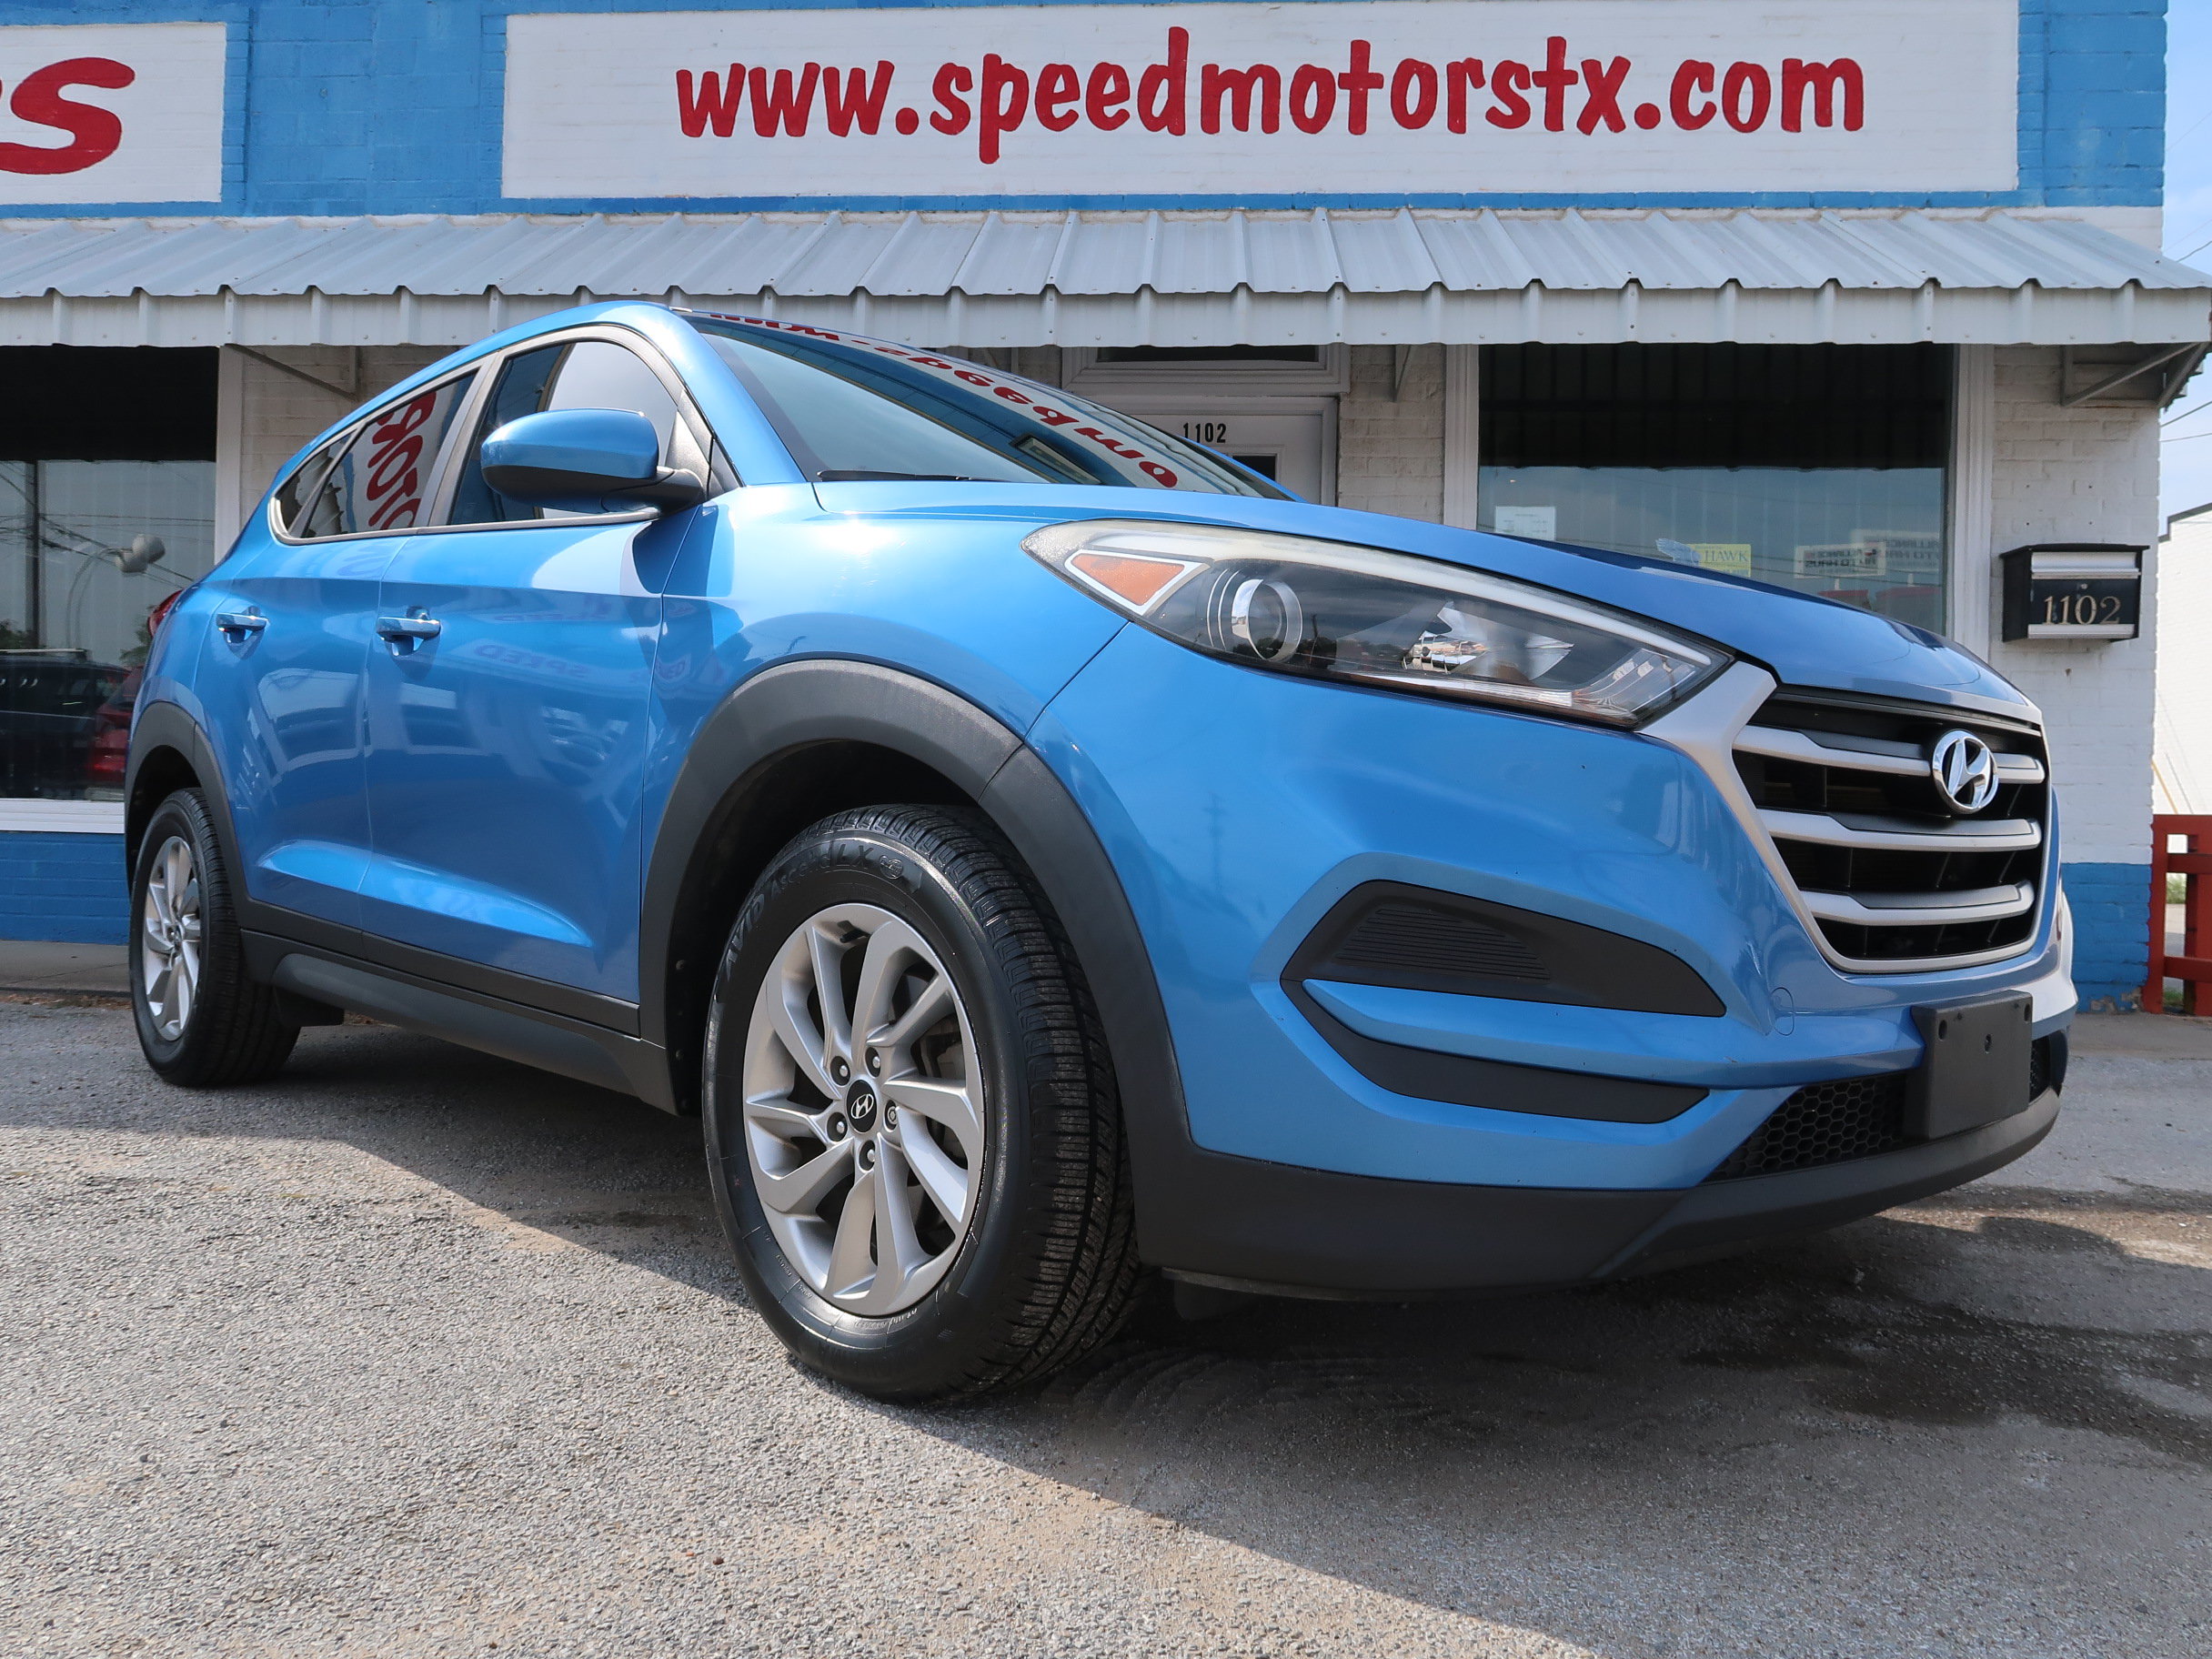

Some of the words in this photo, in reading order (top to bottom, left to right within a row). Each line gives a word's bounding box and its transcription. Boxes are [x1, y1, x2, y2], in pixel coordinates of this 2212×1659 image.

[676, 25, 1865, 165] www.speedmotorstx.com
[0, 56, 136, 176] S
[1182, 422, 1227, 444] 1102
[1704, 550, 1749, 562] HAWK
[2042, 595, 2121, 626] 1102
